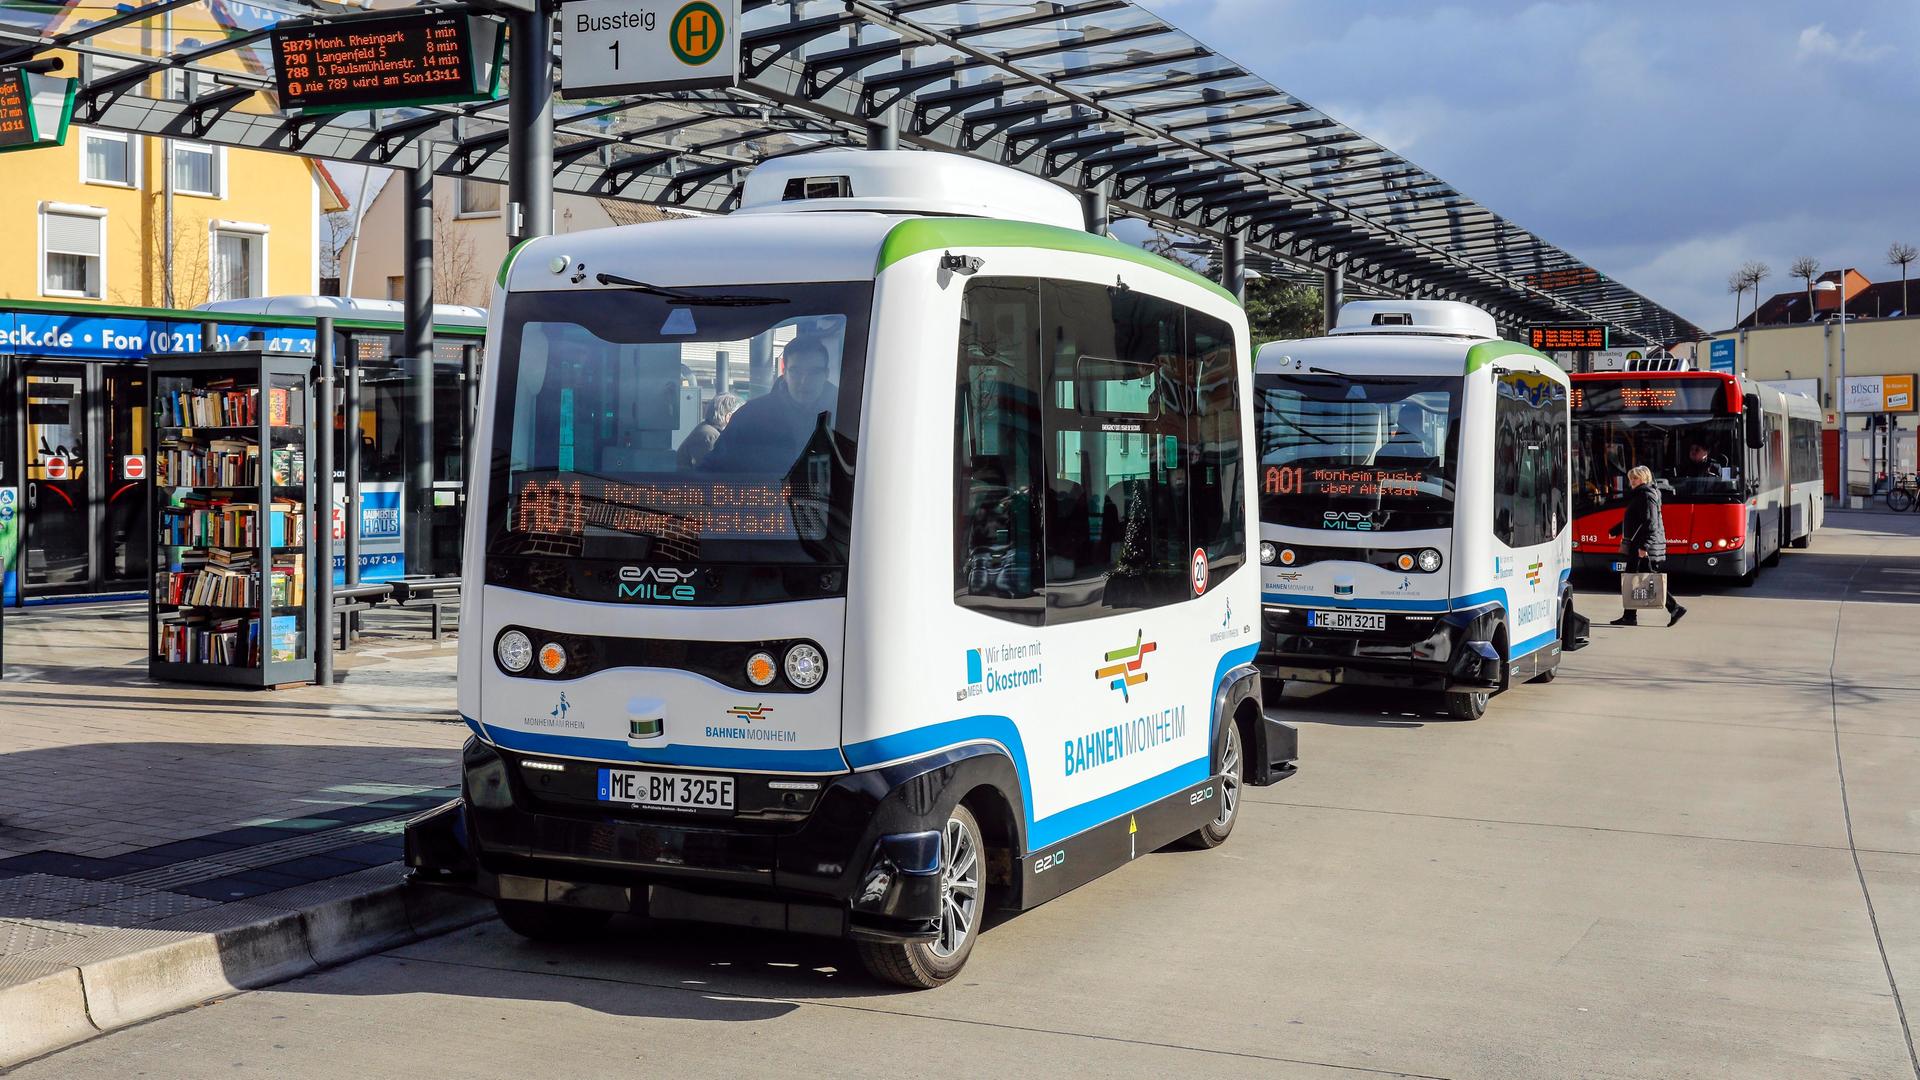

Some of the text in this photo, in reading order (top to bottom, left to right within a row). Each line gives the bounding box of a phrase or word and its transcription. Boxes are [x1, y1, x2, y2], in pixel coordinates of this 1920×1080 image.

[577, 9, 656, 32] Bussteig
[282, 26, 456, 53] SB79 Monh. Rheinpark 1 min
[284, 40, 458, 66] 790 Langenfeld S 8 min
[608, 40, 619, 70] 1
[286, 54, 460, 79] 788 D. Paulsmühlenstr. 14 min
[304, 69, 461, 92] nie 789 wird am Son 13:11
[102, 329, 142, 351] Fon
[1607, 358, 1613, 366] 3
[1851, 384, 1880, 394] BÜSCH
[1266, 466, 1304, 494] A01
[1314, 470, 1372, 482] Monheim
[1320, 483, 1419, 496] über Altstadt
[605, 484, 703, 505] Monheim
[364, 520, 398, 534] HAUS
[683, 512, 786, 532] Altstadt
[370, 556, 380, 565] 47
[382, 556, 397, 564] 3-0
[1196, 561, 1204, 582] 20
[1316, 613, 1330, 626] ME
[1338, 614, 1352, 627] BM
[1355, 615, 1384, 629] 321E
[985, 640, 1042, 664] Wir fahren mit
[986, 663, 1042, 693] Ökostrom!
[968, 684, 983, 697] MEGA
[601, 773, 732, 807] D ME BM 325E
